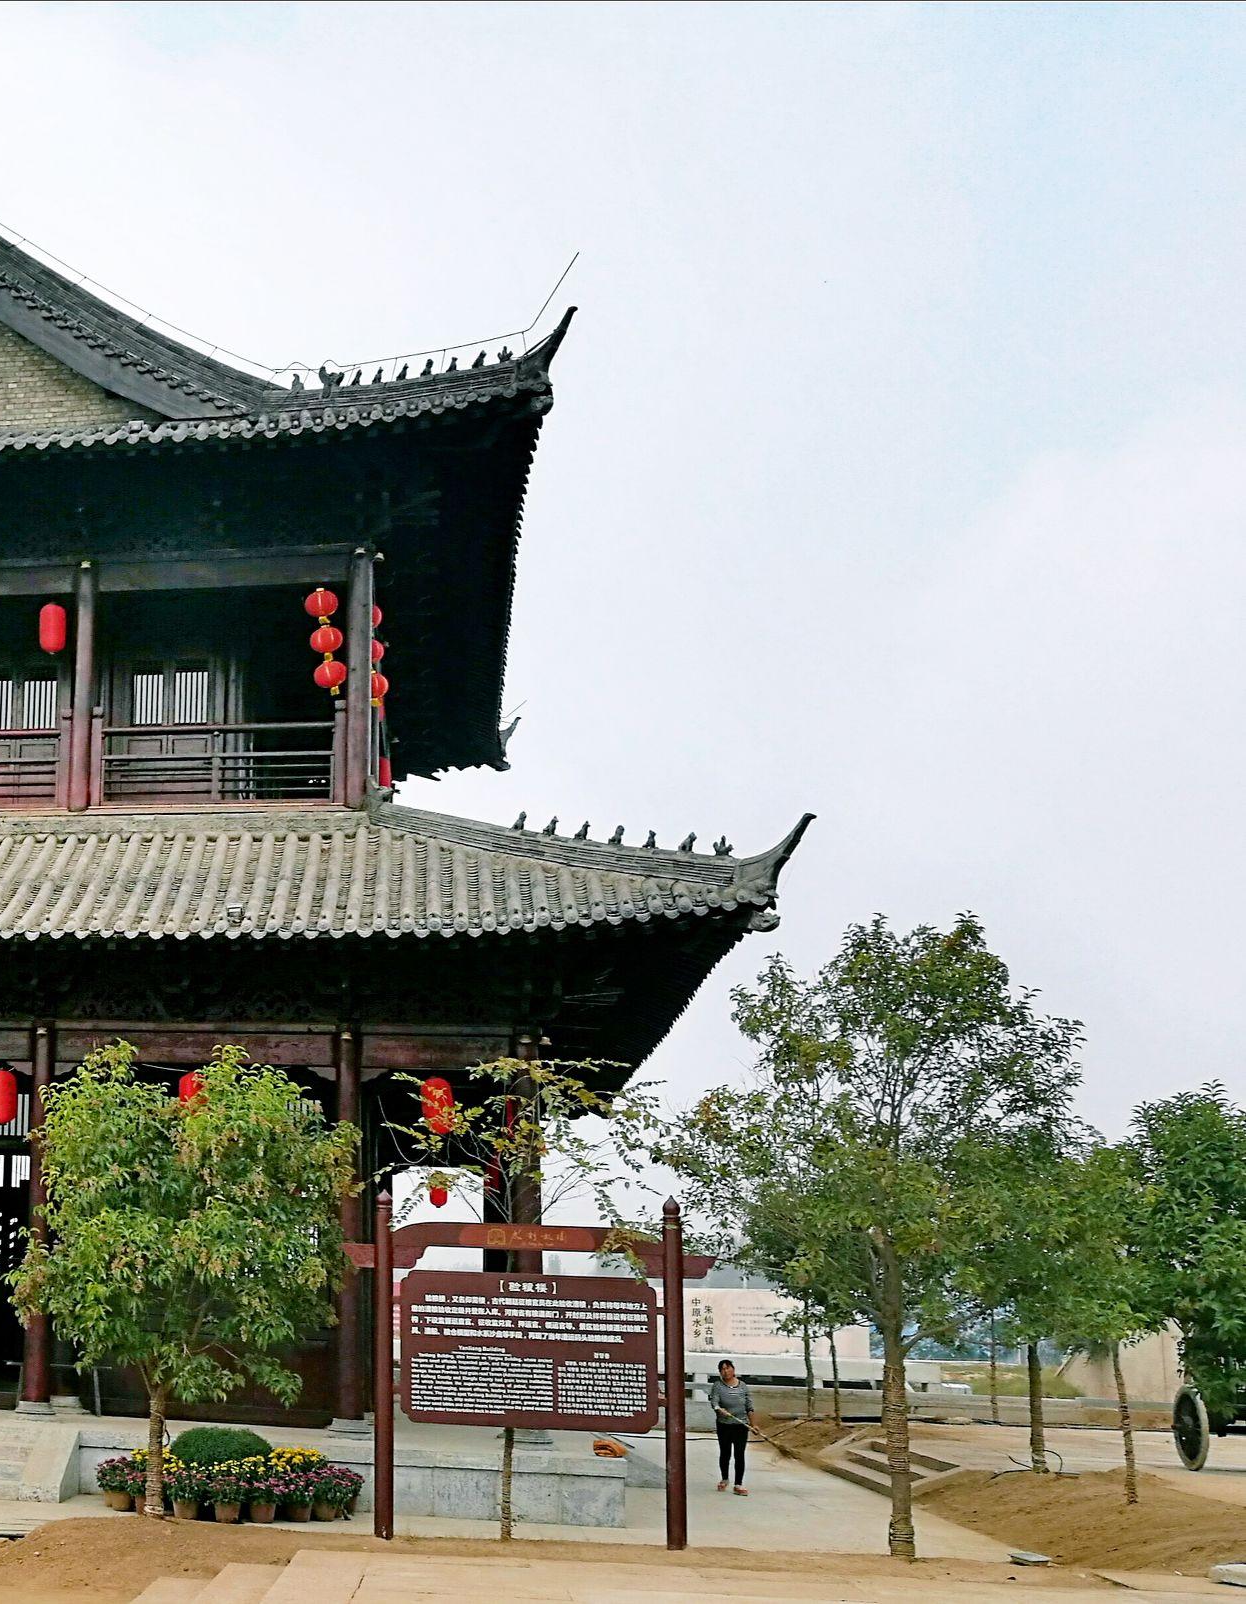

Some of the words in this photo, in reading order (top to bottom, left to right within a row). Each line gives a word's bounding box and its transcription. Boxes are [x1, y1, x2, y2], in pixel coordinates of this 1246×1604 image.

[691, 1297, 702, 1339] 中原水乡
[703, 1305, 714, 1346] 朱仙古镇
[482, 1345, 506, 1353] Building
